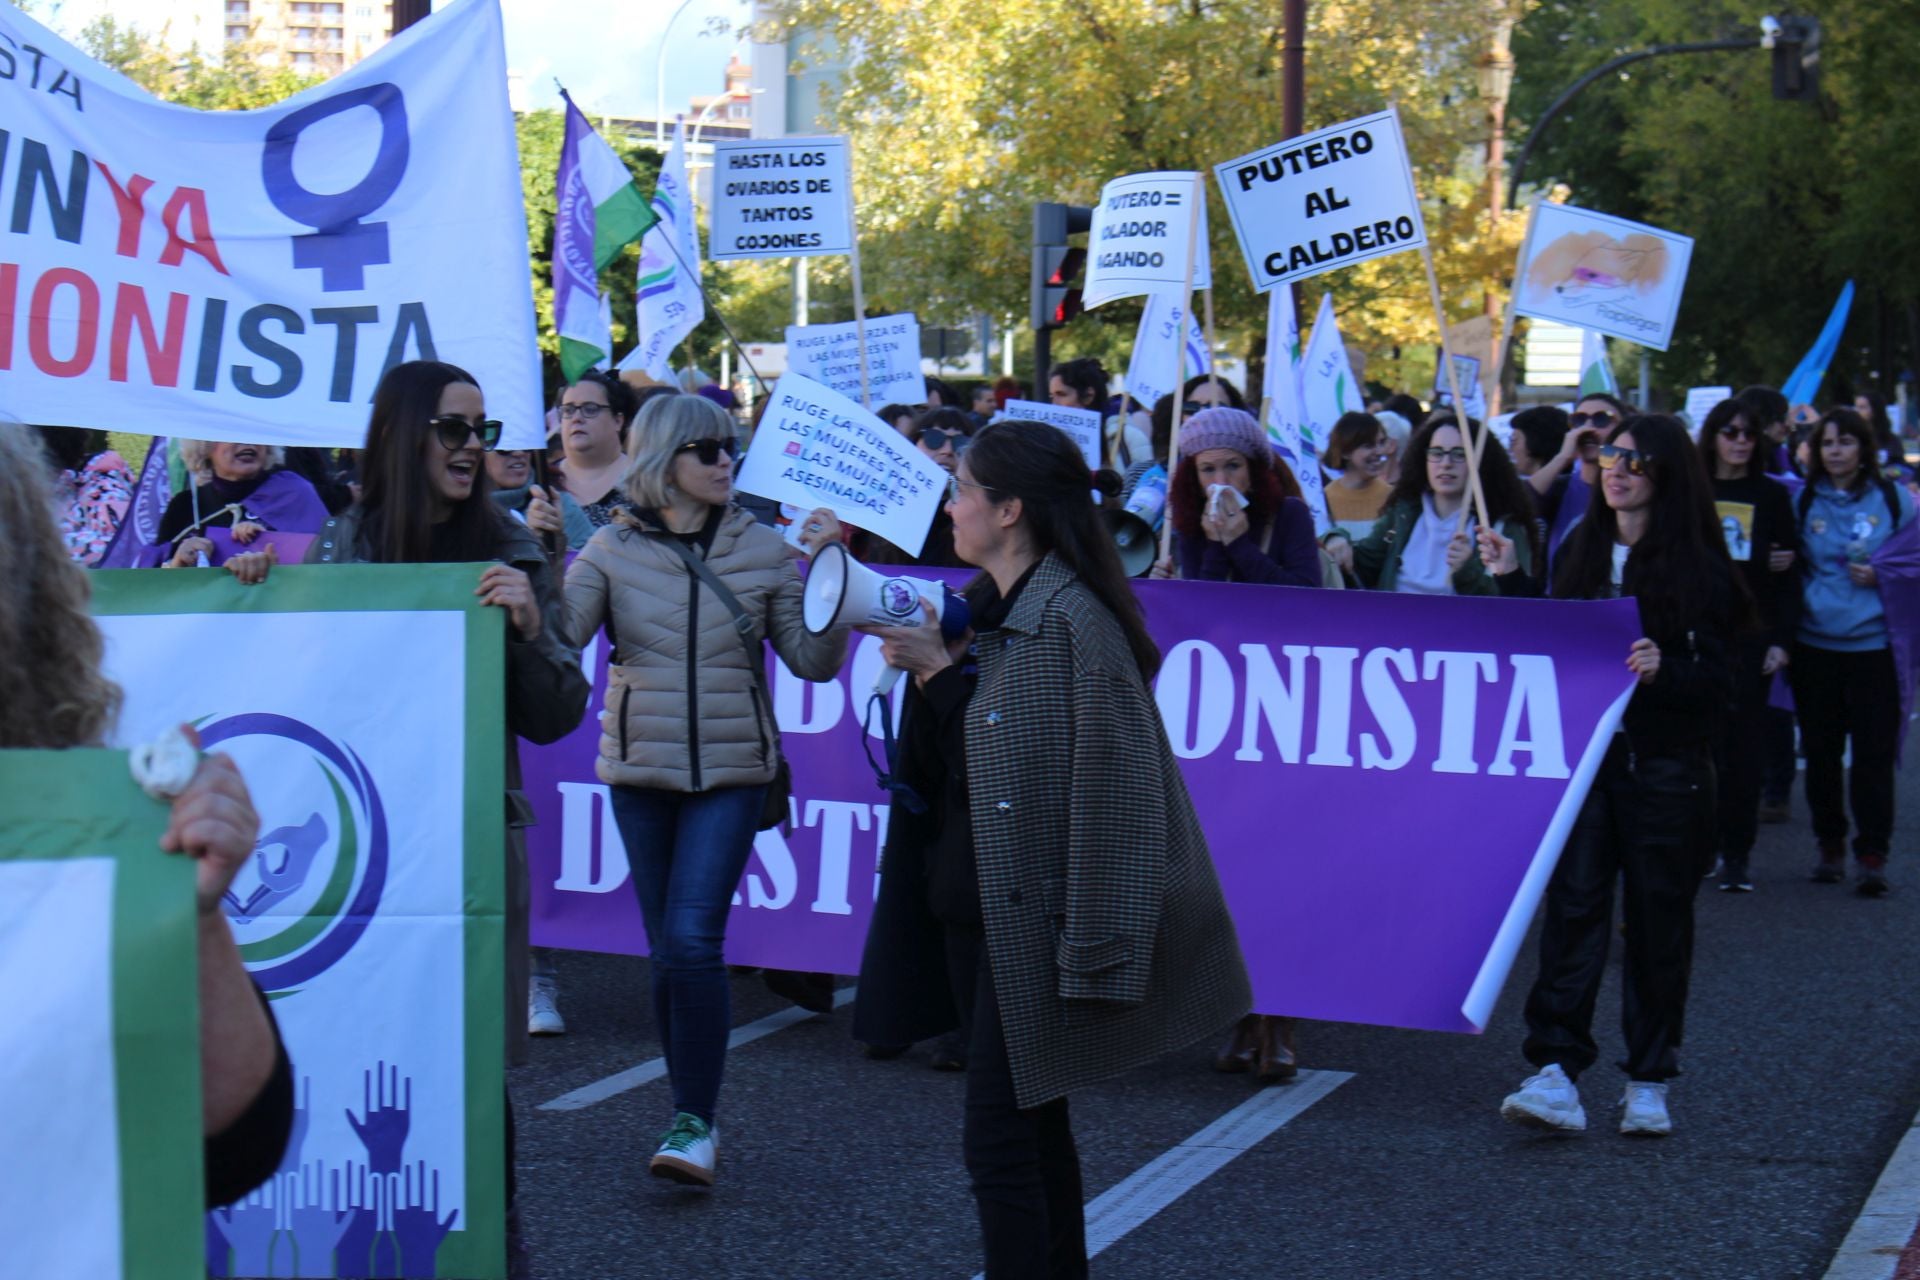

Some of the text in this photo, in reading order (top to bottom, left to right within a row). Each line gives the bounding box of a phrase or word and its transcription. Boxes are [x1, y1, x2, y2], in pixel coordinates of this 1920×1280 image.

[729, 152, 826, 169] HASTA LOS
[1237, 130, 1374, 192] PUTERO
[726, 179, 832, 197] OVARIOS DE
[741, 206, 813, 222] TANTOS
[1305, 187, 1351, 218] AL
[735, 233, 822, 249] COJONES
[1264, 216, 1414, 276] CALDERO
[796, 324, 907, 349] RUGE LA FURZA DE
[808, 342, 899, 363] LAS MUJEES EN
[822, 359, 887, 377] CONTR DE
[781, 395, 830, 421] RUGE
[831, 413, 851, 433] LA
[856, 428, 912, 473] FUERZA
[915, 470, 935, 490] DE
[779, 417, 919, 497] LAS MUJERES POR
[781, 467, 888, 516] ASESINADAS
[800, 448, 905, 507] LAS MUJERES
